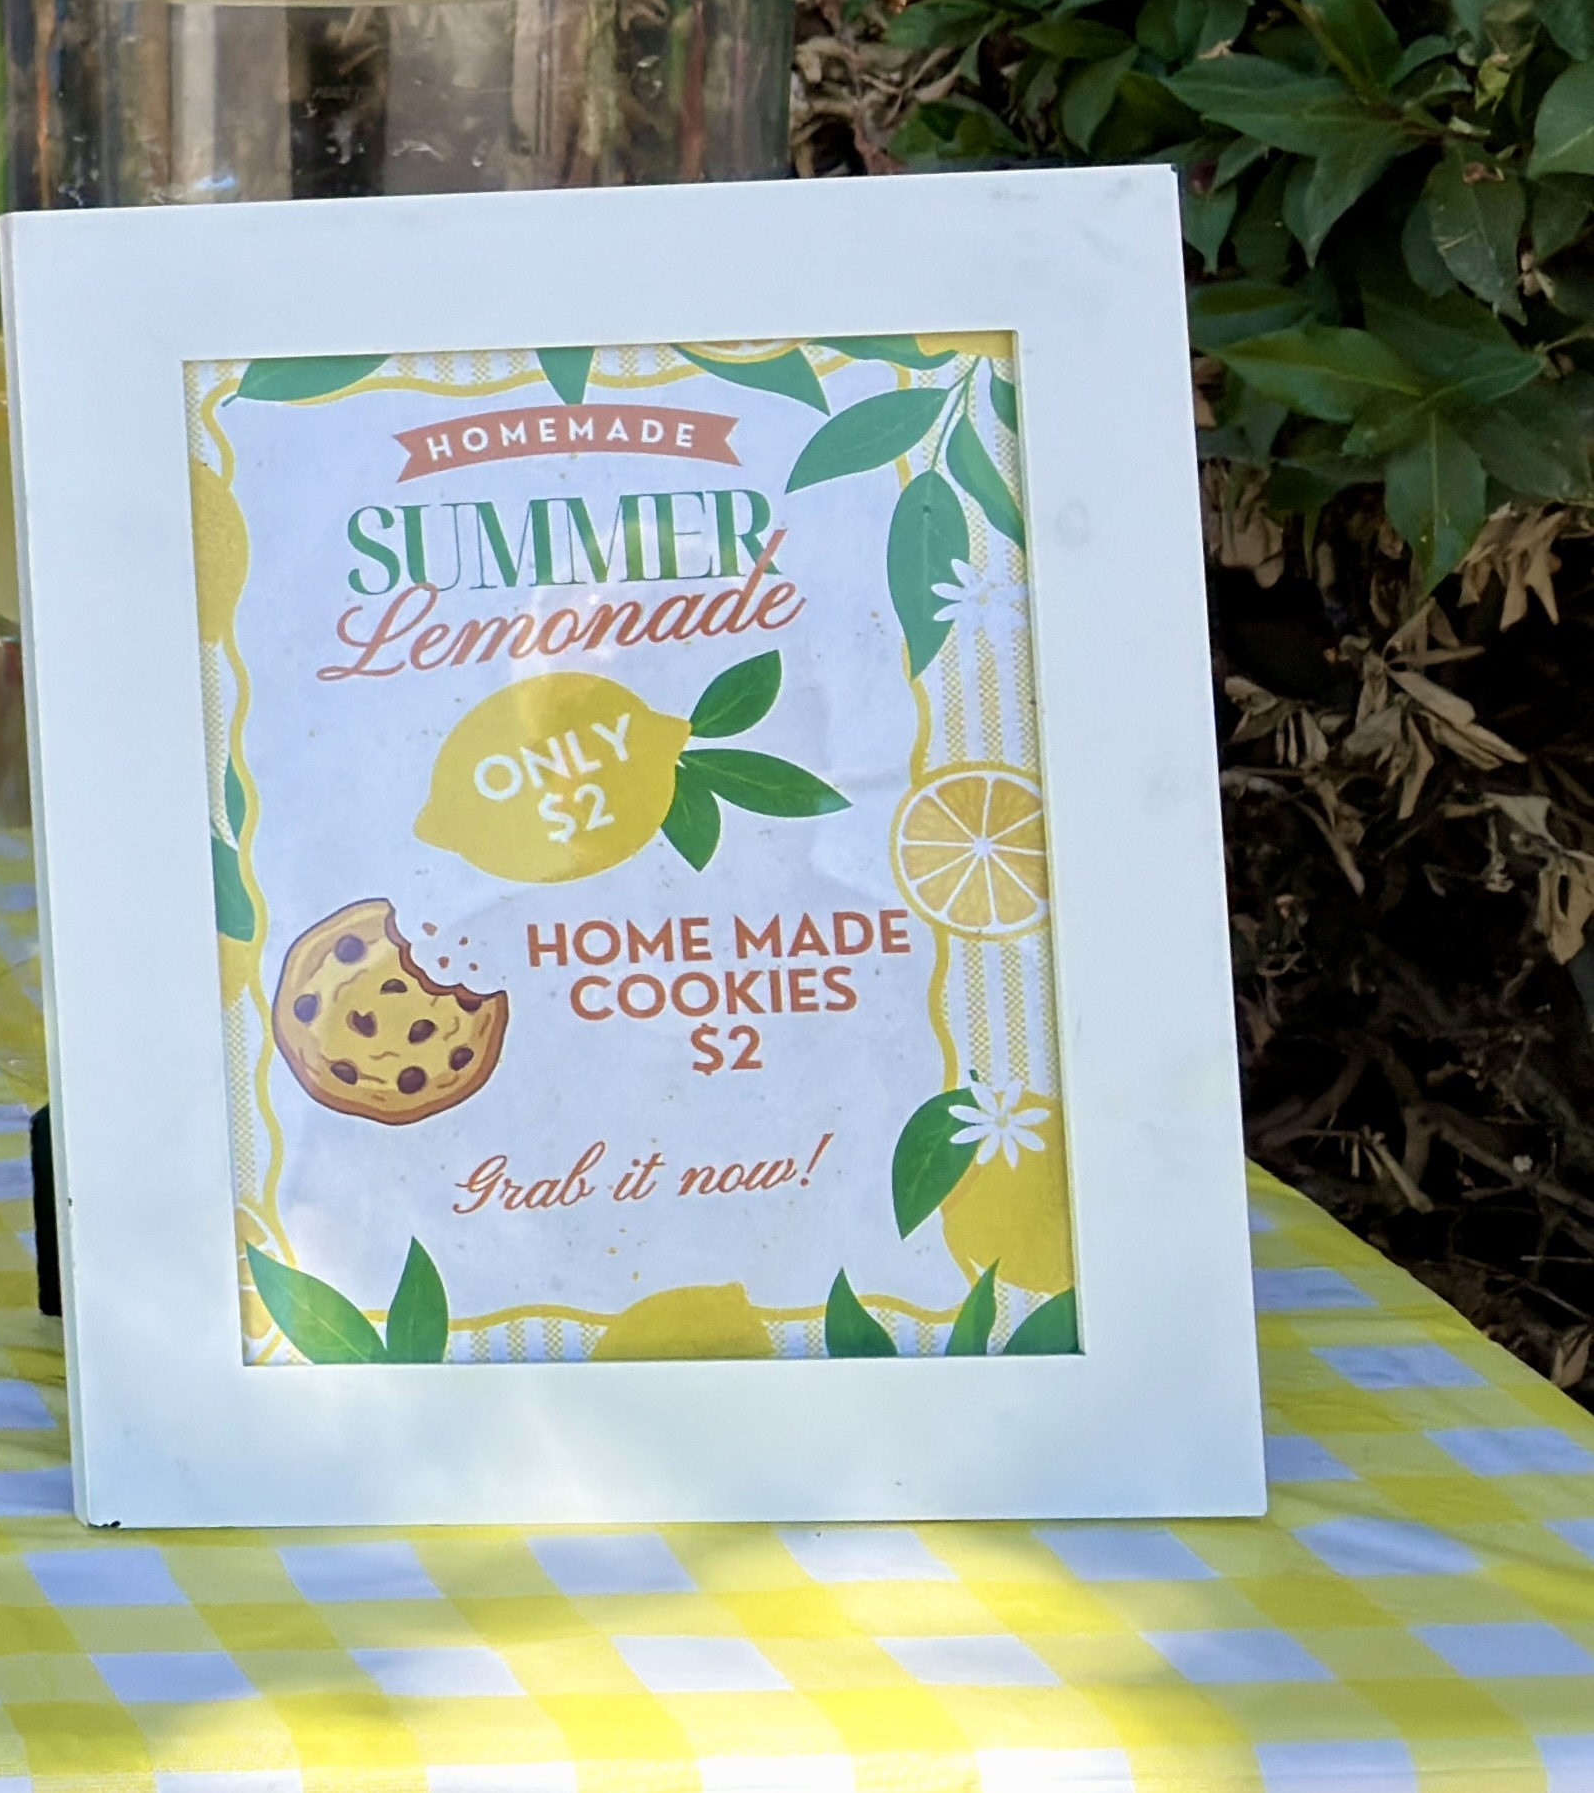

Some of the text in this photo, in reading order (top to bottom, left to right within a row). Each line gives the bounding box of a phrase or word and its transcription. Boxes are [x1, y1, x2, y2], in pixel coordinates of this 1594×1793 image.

[426, 415, 698, 464] HOMEMADE
[345, 487, 781, 596] SUMMER
[316, 529, 807, 682] Lemonade
[473, 712, 632, 803] ONLY
[538, 781, 615, 845] $2
[526, 908, 911, 968] HOME MADE
[568, 964, 859, 1022] COOKIES
[690, 1022, 764, 1077] $2
[452, 1132, 836, 1215] Grab it now!
